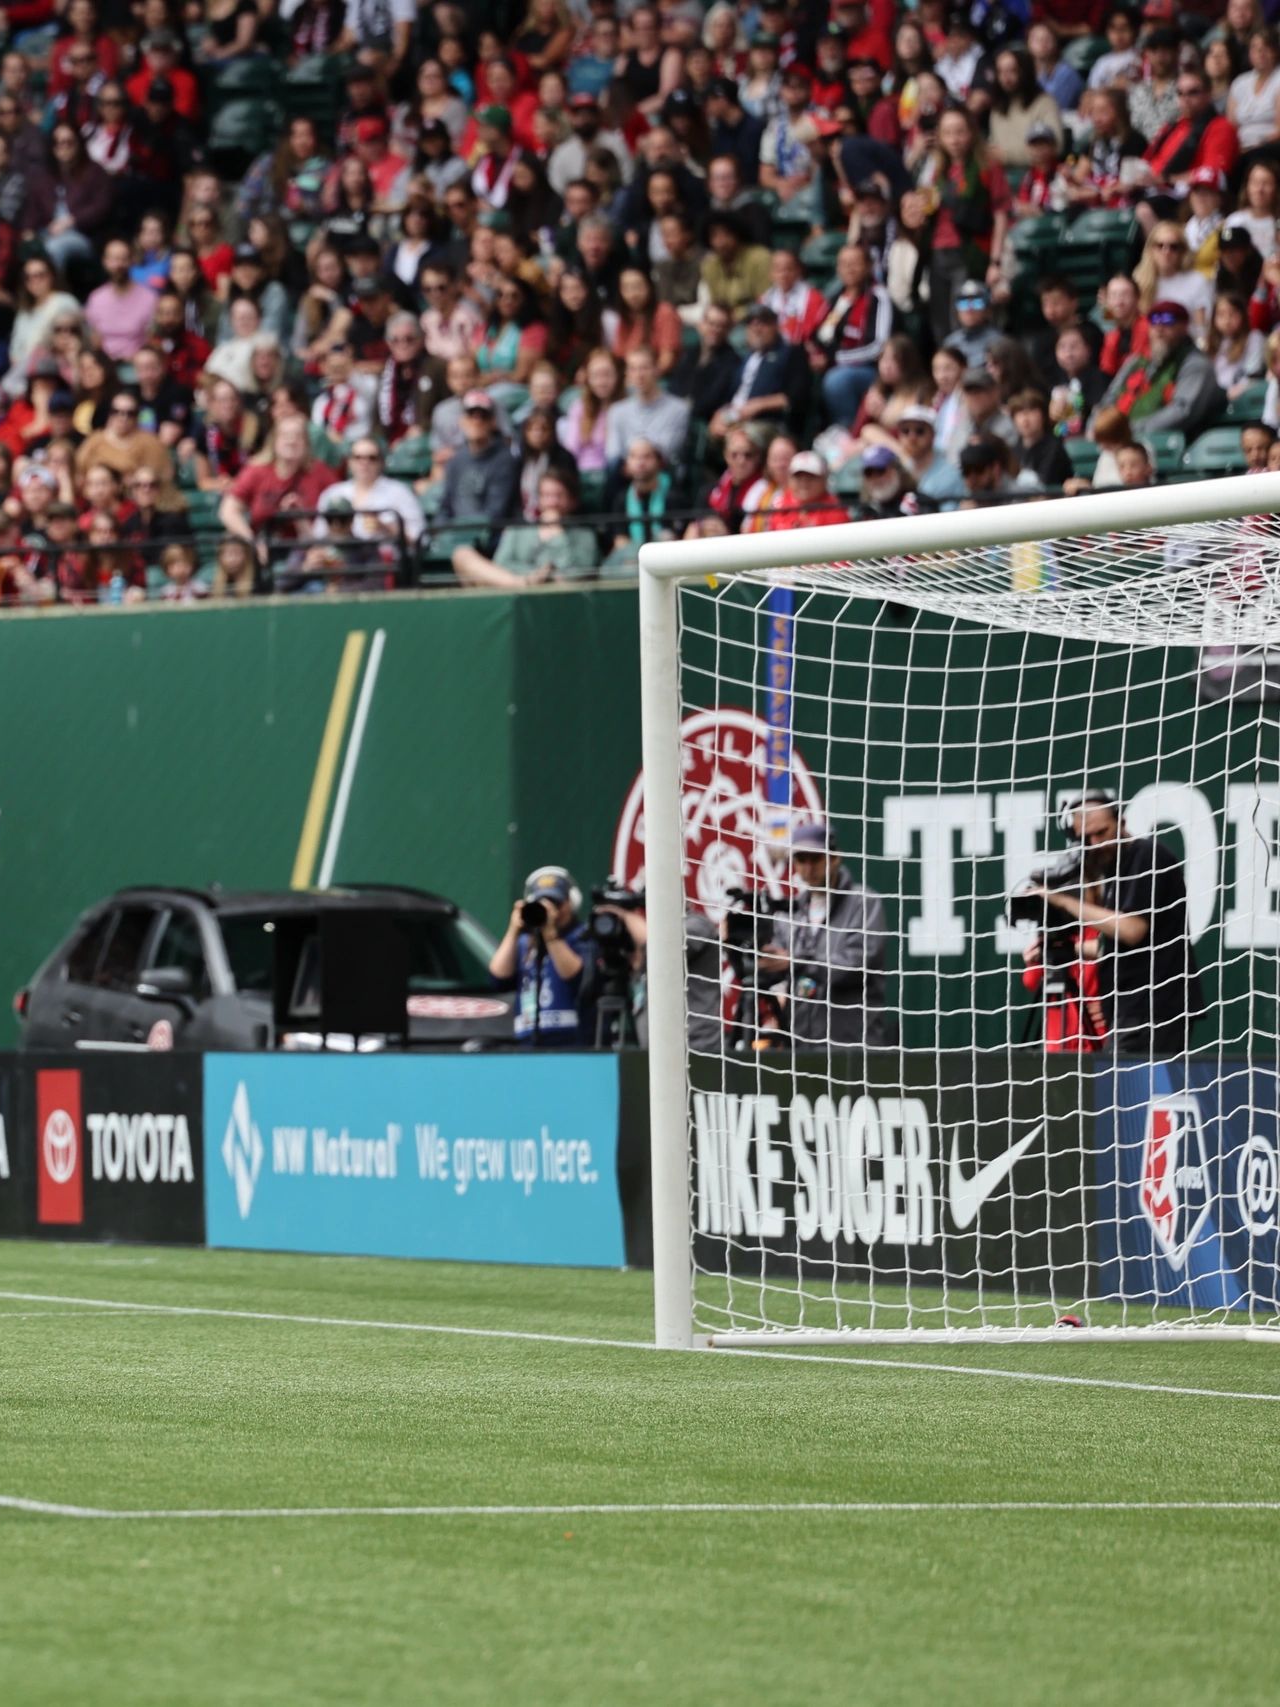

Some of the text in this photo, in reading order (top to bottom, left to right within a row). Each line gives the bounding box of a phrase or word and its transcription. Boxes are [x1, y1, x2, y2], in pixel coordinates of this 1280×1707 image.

[86, 1112, 195, 1183] TOYOTA
[272, 1122, 399, 1179] NW Natural
[415, 1123, 599, 1197] We grew up here.
[694, 1093, 786, 1238] NIKE
